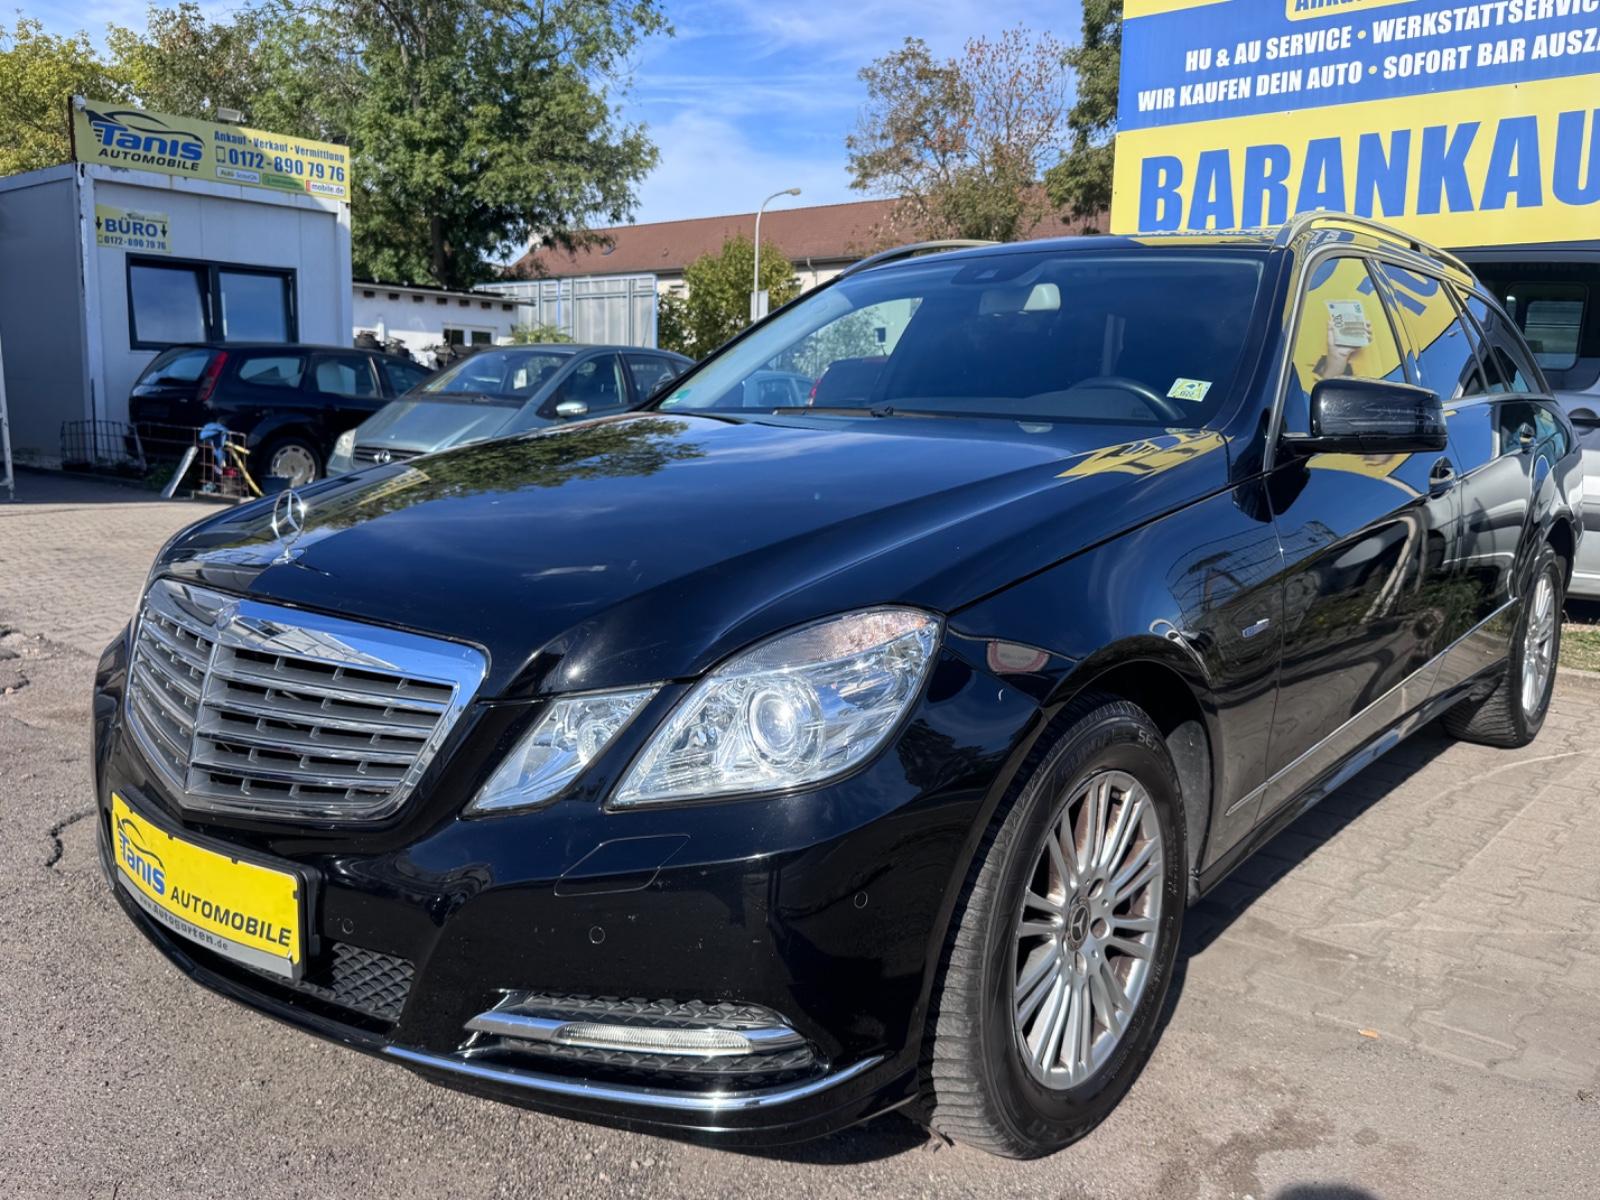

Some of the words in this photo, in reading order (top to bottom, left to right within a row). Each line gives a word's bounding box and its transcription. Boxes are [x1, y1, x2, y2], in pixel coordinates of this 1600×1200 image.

[1185, 47, 1212, 72] HU
[1216, 48, 1230, 67] &
[1234, 40, 1261, 65] AU
[1265, 25, 1352, 60] SERVICE
[1138, 87, 1175, 112] WIR
[1179, 76, 1251, 106] KAUFEN
[1256, 69, 1303, 96] DEIN
[1306, 60, 1363, 90] AUTO
[1383, 45, 1472, 80] SOFORT
[1477, 38, 1526, 67] BAR
[1531, 27, 1600, 60] AUSZ
[98, 148, 200, 172] AUTOMOBILE
[214, 130, 247, 145] Ankauf
[253, 138, 289, 153] Verkauf
[294, 145, 345, 164] Vermittlung
[307, 161, 330, 179] 79
[328, 165, 345, 182] 76
[1138, 107, 1600, 232] BARANKAU
[105, 216, 158, 237] BÜRO
[171, 886, 292, 947] AUTOMOBILE
